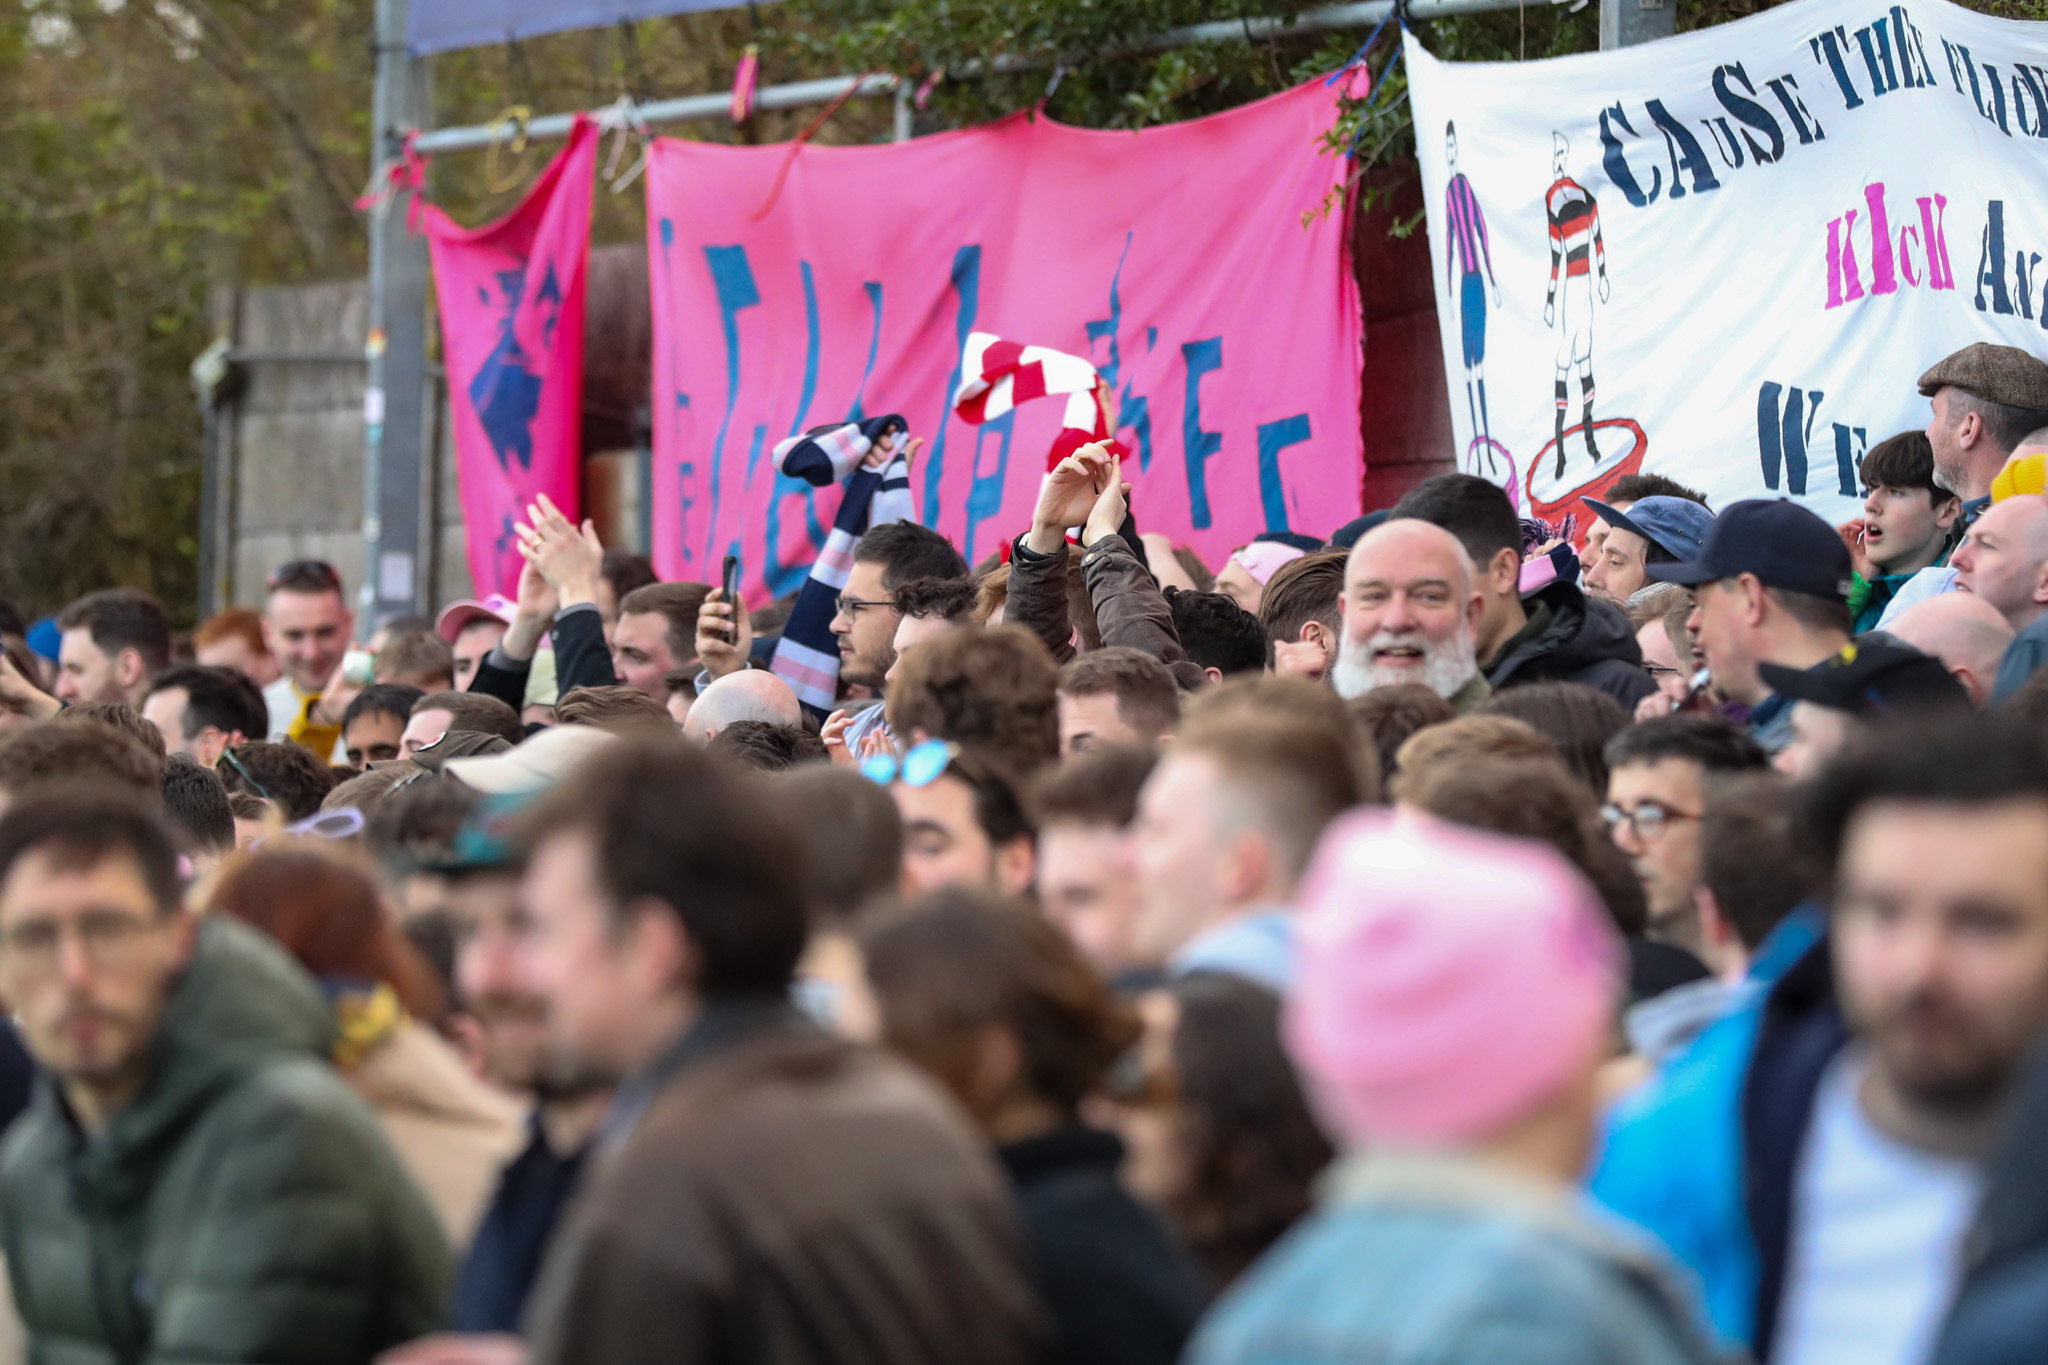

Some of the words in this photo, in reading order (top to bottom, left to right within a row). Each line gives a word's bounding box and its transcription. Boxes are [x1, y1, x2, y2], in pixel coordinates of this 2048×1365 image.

[1599, 60, 1826, 208] CAUSE
[1808, 5, 1938, 111] THEY
[1940, 34, 2048, 138] FLICK
[1824, 182, 1956, 310] KICK
[1974, 199, 2048, 330] AN
[1757, 380, 1869, 499] WE
